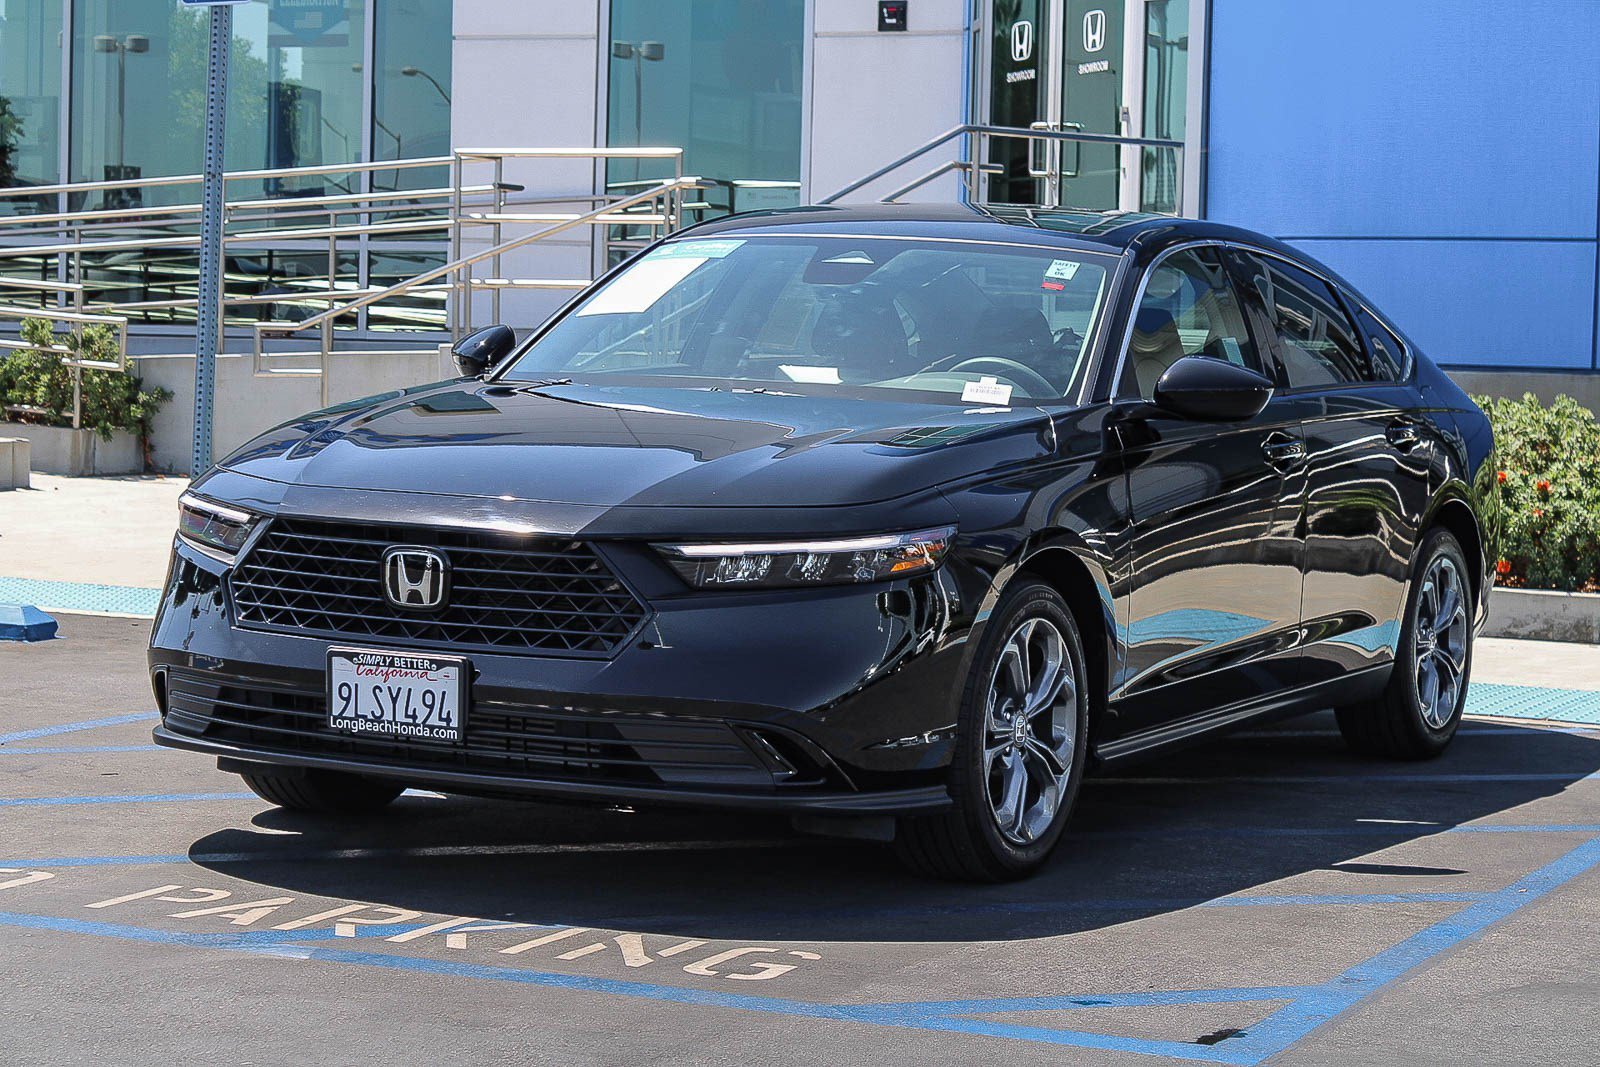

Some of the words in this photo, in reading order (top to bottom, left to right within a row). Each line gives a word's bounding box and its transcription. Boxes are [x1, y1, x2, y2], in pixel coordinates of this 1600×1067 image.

[1006, 69, 1036, 83] SHOWROOM
[1078, 60, 1109, 75] SHOWROOM
[394, 657, 431, 670] BETTER
[355, 664, 438, 683] California
[337, 682, 453, 727] 9LSY494
[330, 716, 458, 739] LongBeachHonda.com
[84, 884, 821, 980] PARKING
